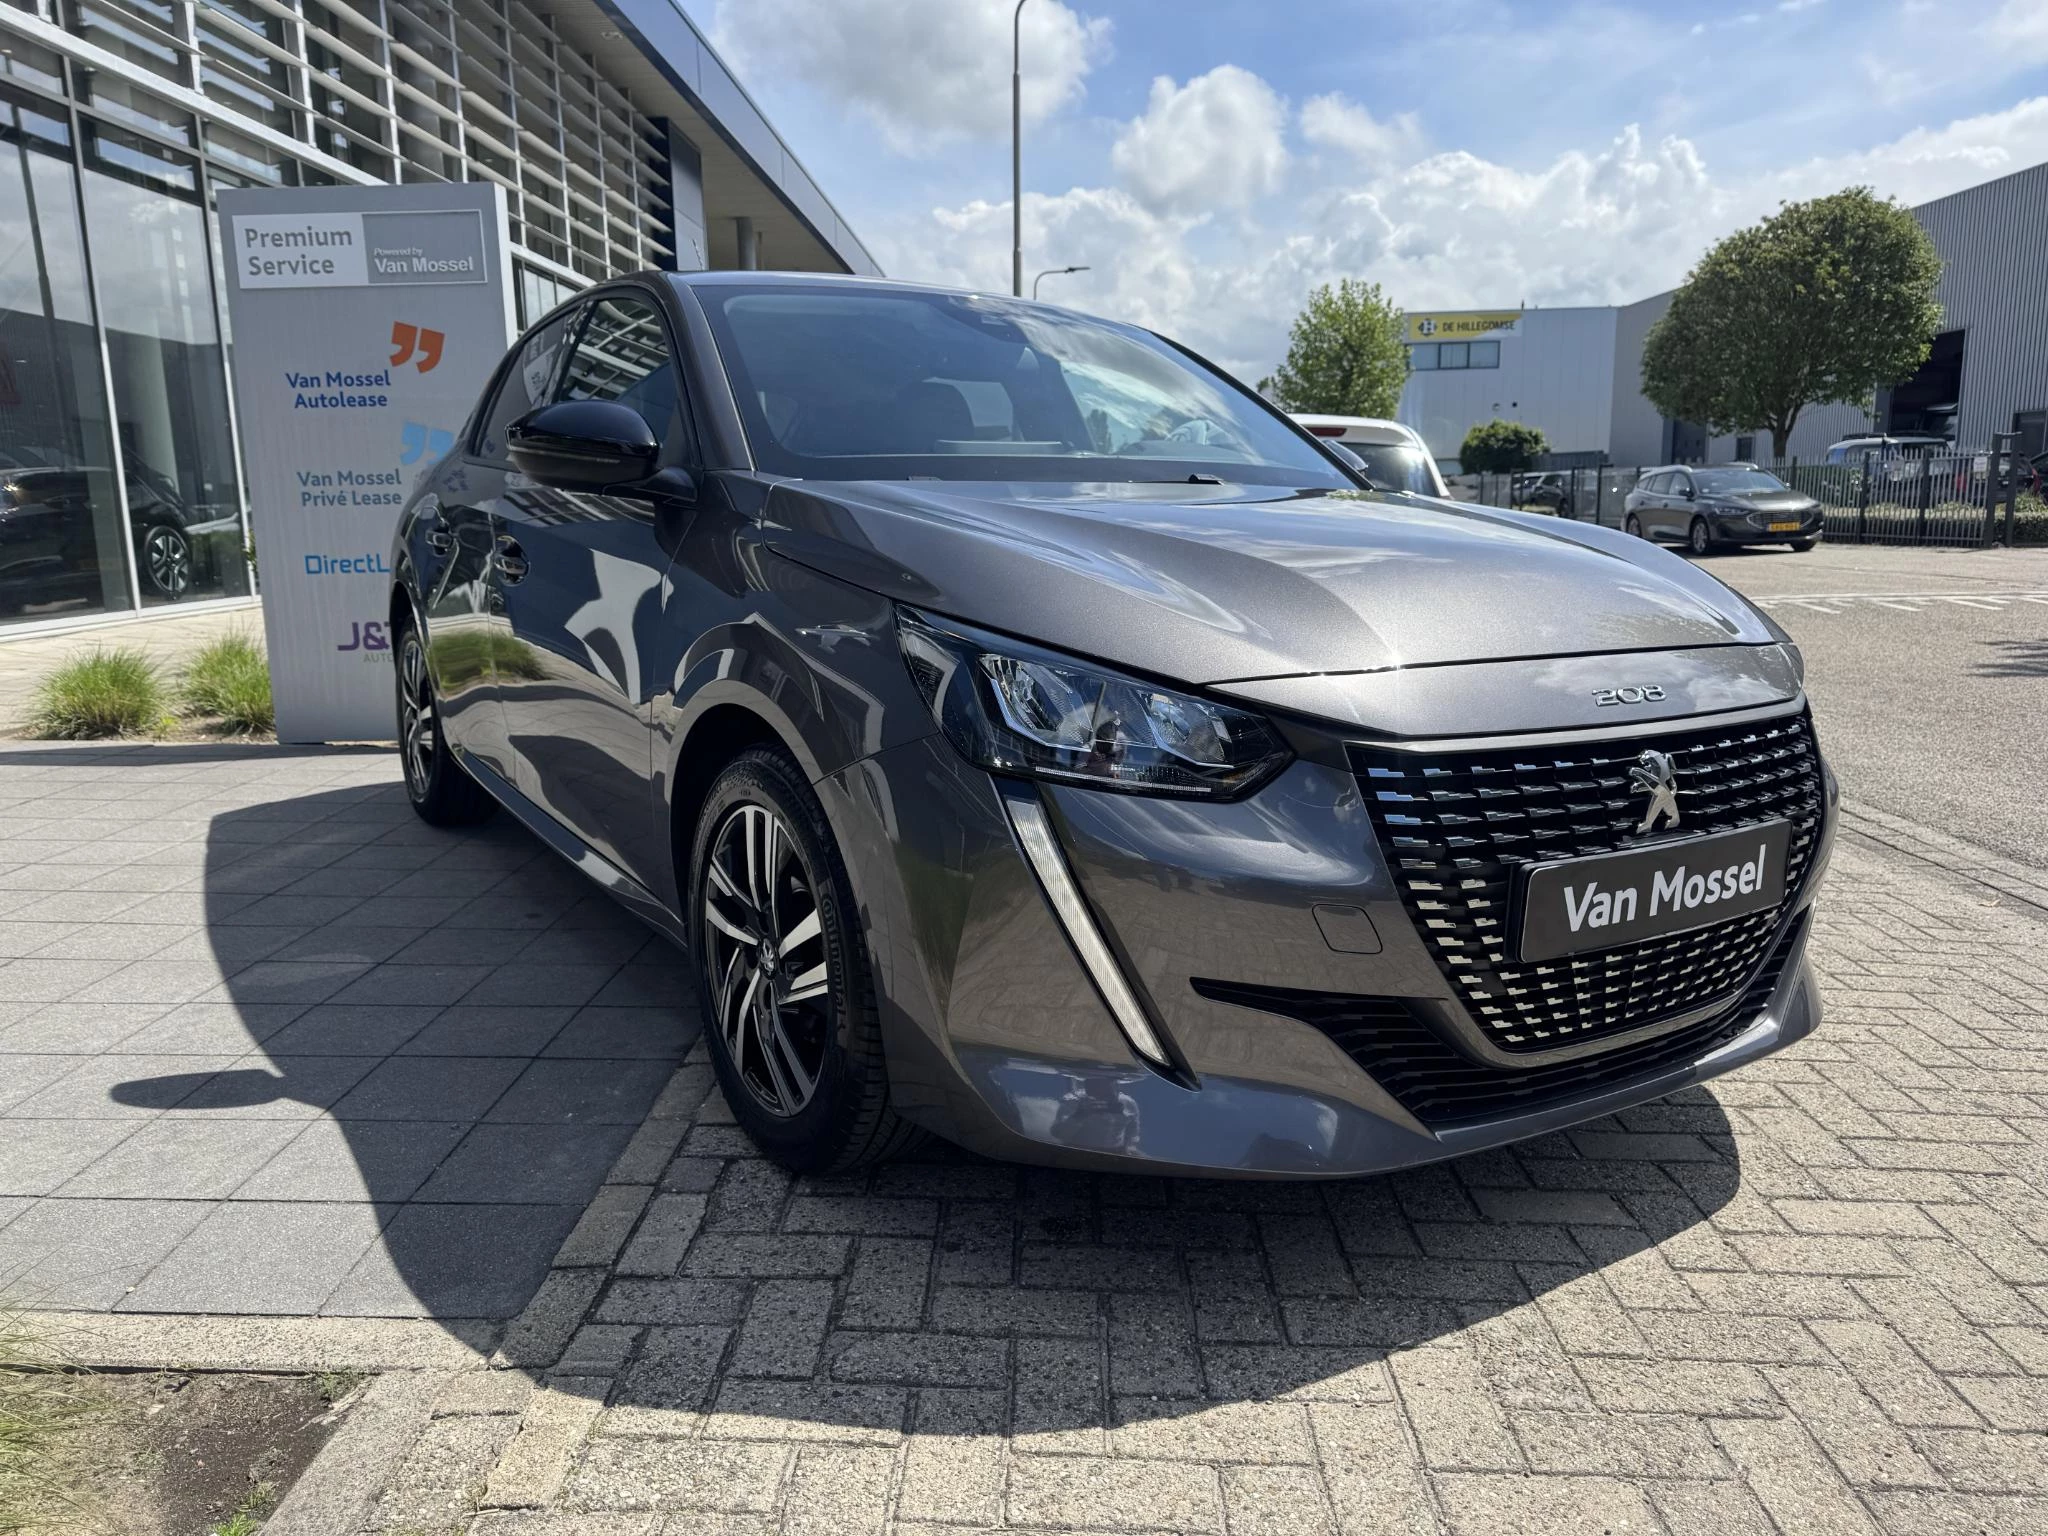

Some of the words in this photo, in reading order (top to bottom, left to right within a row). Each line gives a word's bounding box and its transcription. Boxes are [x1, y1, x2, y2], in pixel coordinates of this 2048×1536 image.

[244, 225, 353, 249] Premium
[374, 247, 411, 256] Powered
[412, 247, 423, 257] by
[248, 255, 336, 276] Service
[374, 257, 408, 273] Van
[412, 255, 474, 273] Mossel
[1442, 321, 1454, 333] DE
[1456, 319, 1516, 332] HILLEGOMSE
[285, 372, 321, 389] Van
[326, 369, 392, 388] Mossel
[294, 391, 388, 409] Autolease
[296, 471, 333, 487] Van
[338, 468, 402, 486] Mossel
[301, 490, 347, 507] Privé
[352, 491, 402, 506] Lease
[337, 621, 390, 651] J&
[1592, 684, 1667, 707] 208
[1563, 882, 1638, 933] Van
[1649, 843, 1767, 917] Mossel
